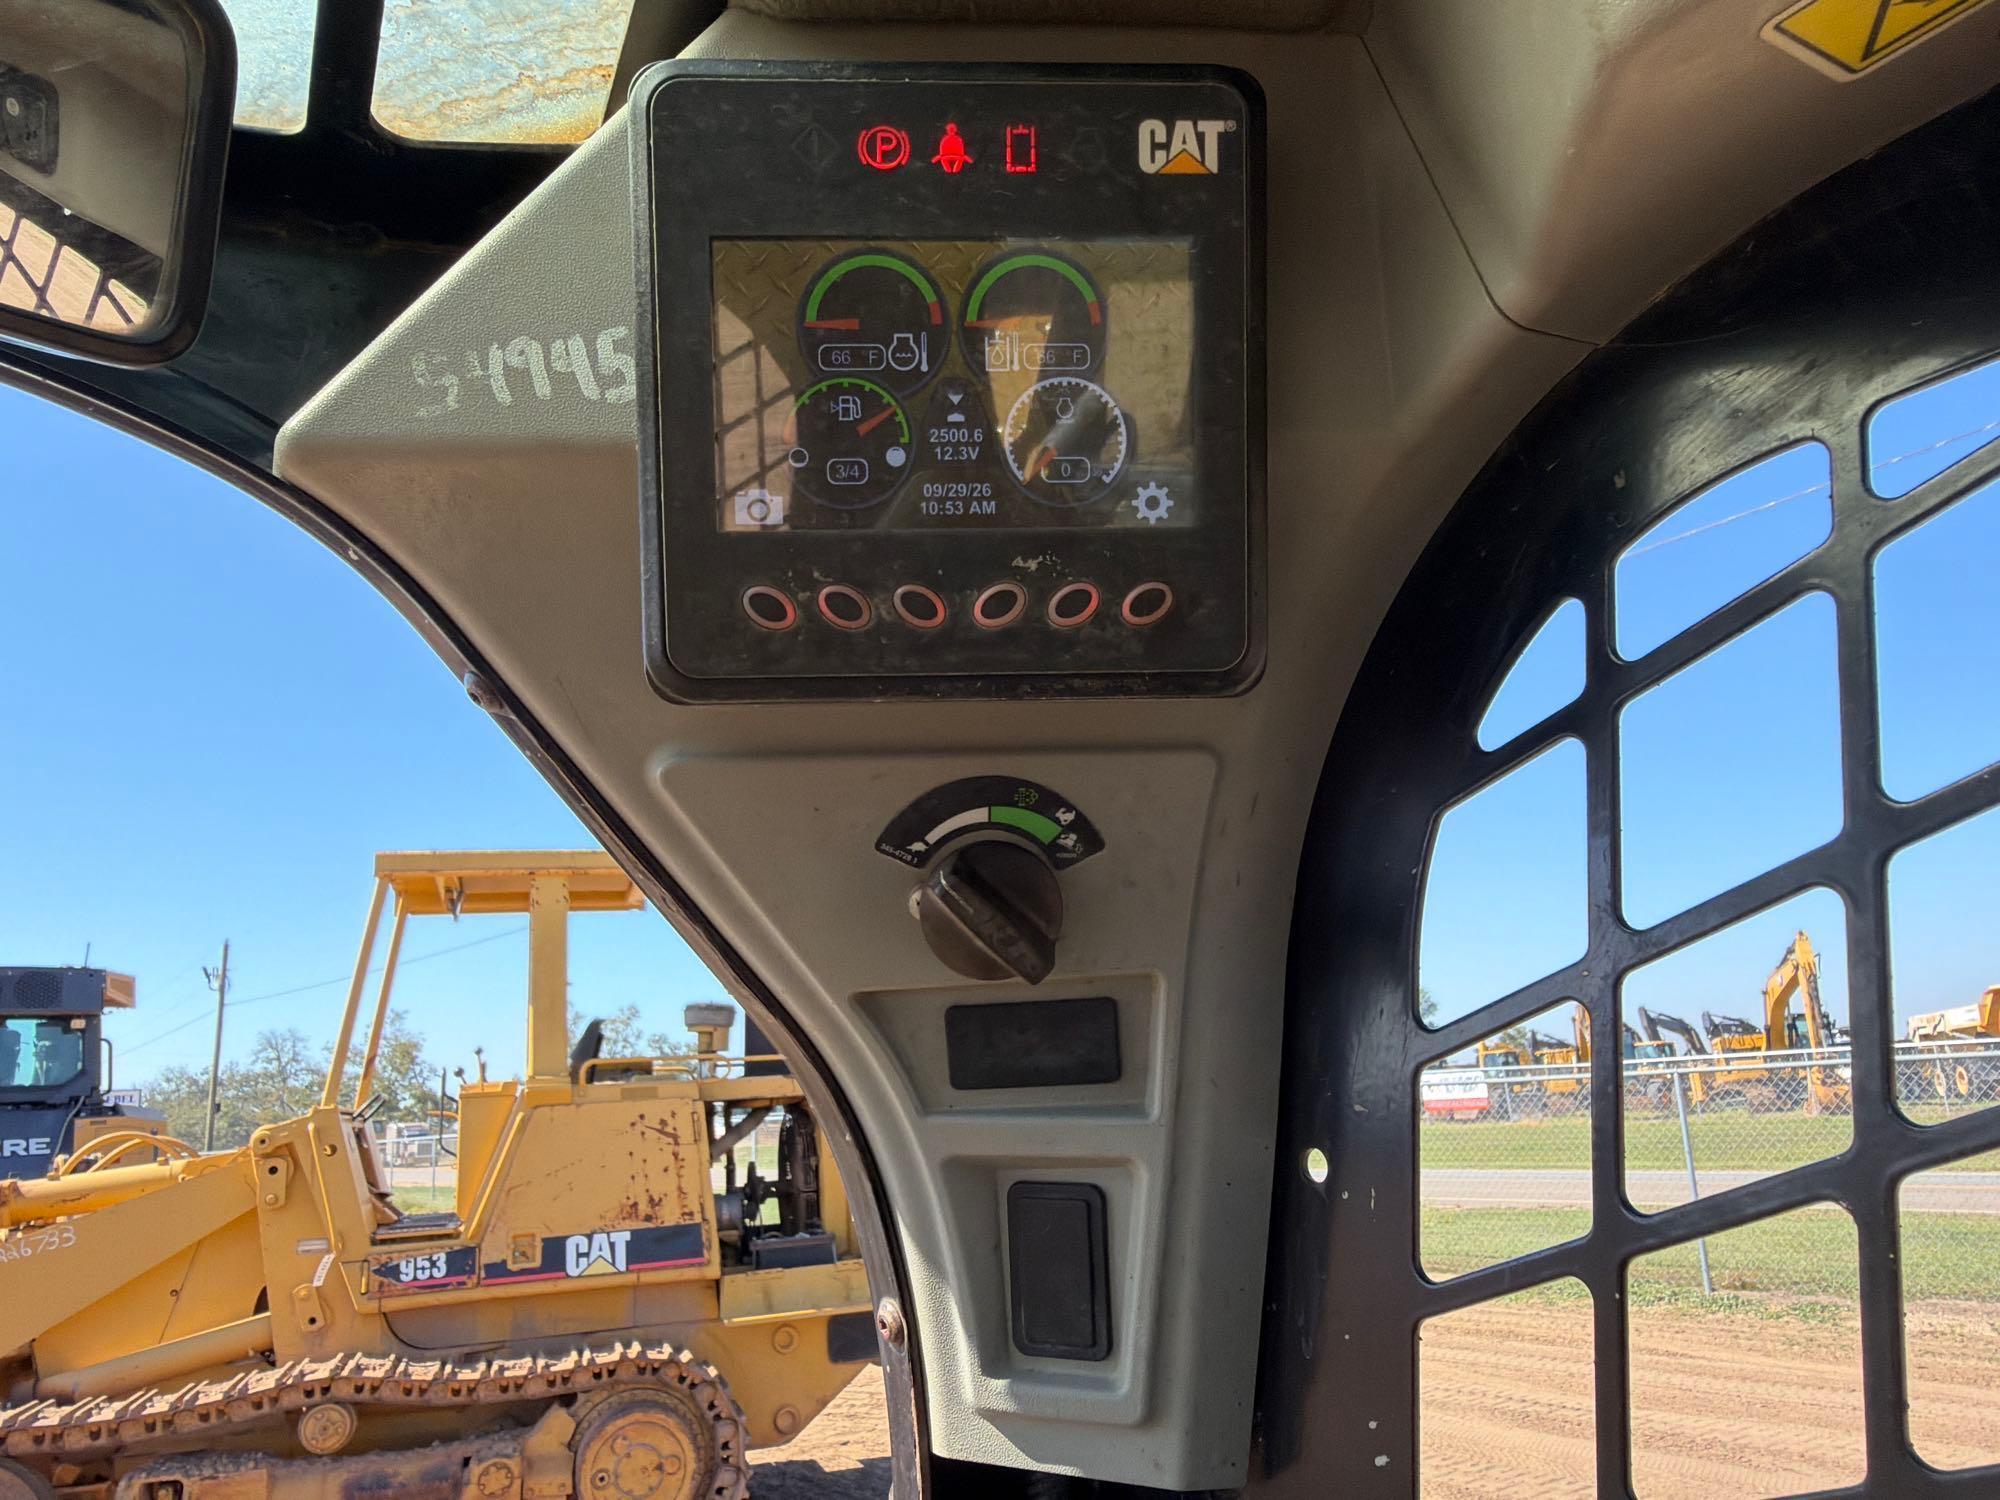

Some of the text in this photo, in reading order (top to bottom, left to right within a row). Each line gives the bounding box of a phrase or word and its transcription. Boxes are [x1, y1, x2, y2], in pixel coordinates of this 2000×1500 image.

[831, 350, 878, 365] 66 F
[1073, 350, 1083, 364] F
[929, 428, 983, 442] 2500.6
[934, 446, 980, 460] 12.3V
[835, 464, 860, 479] 3/4
[1061, 463, 1071, 477] 0
[923, 483, 992, 497] 09/29/26
[920, 501, 996, 515] 10:53 AM
[565, 1231, 631, 1277] CAT
[400, 1252, 447, 1282] 953
